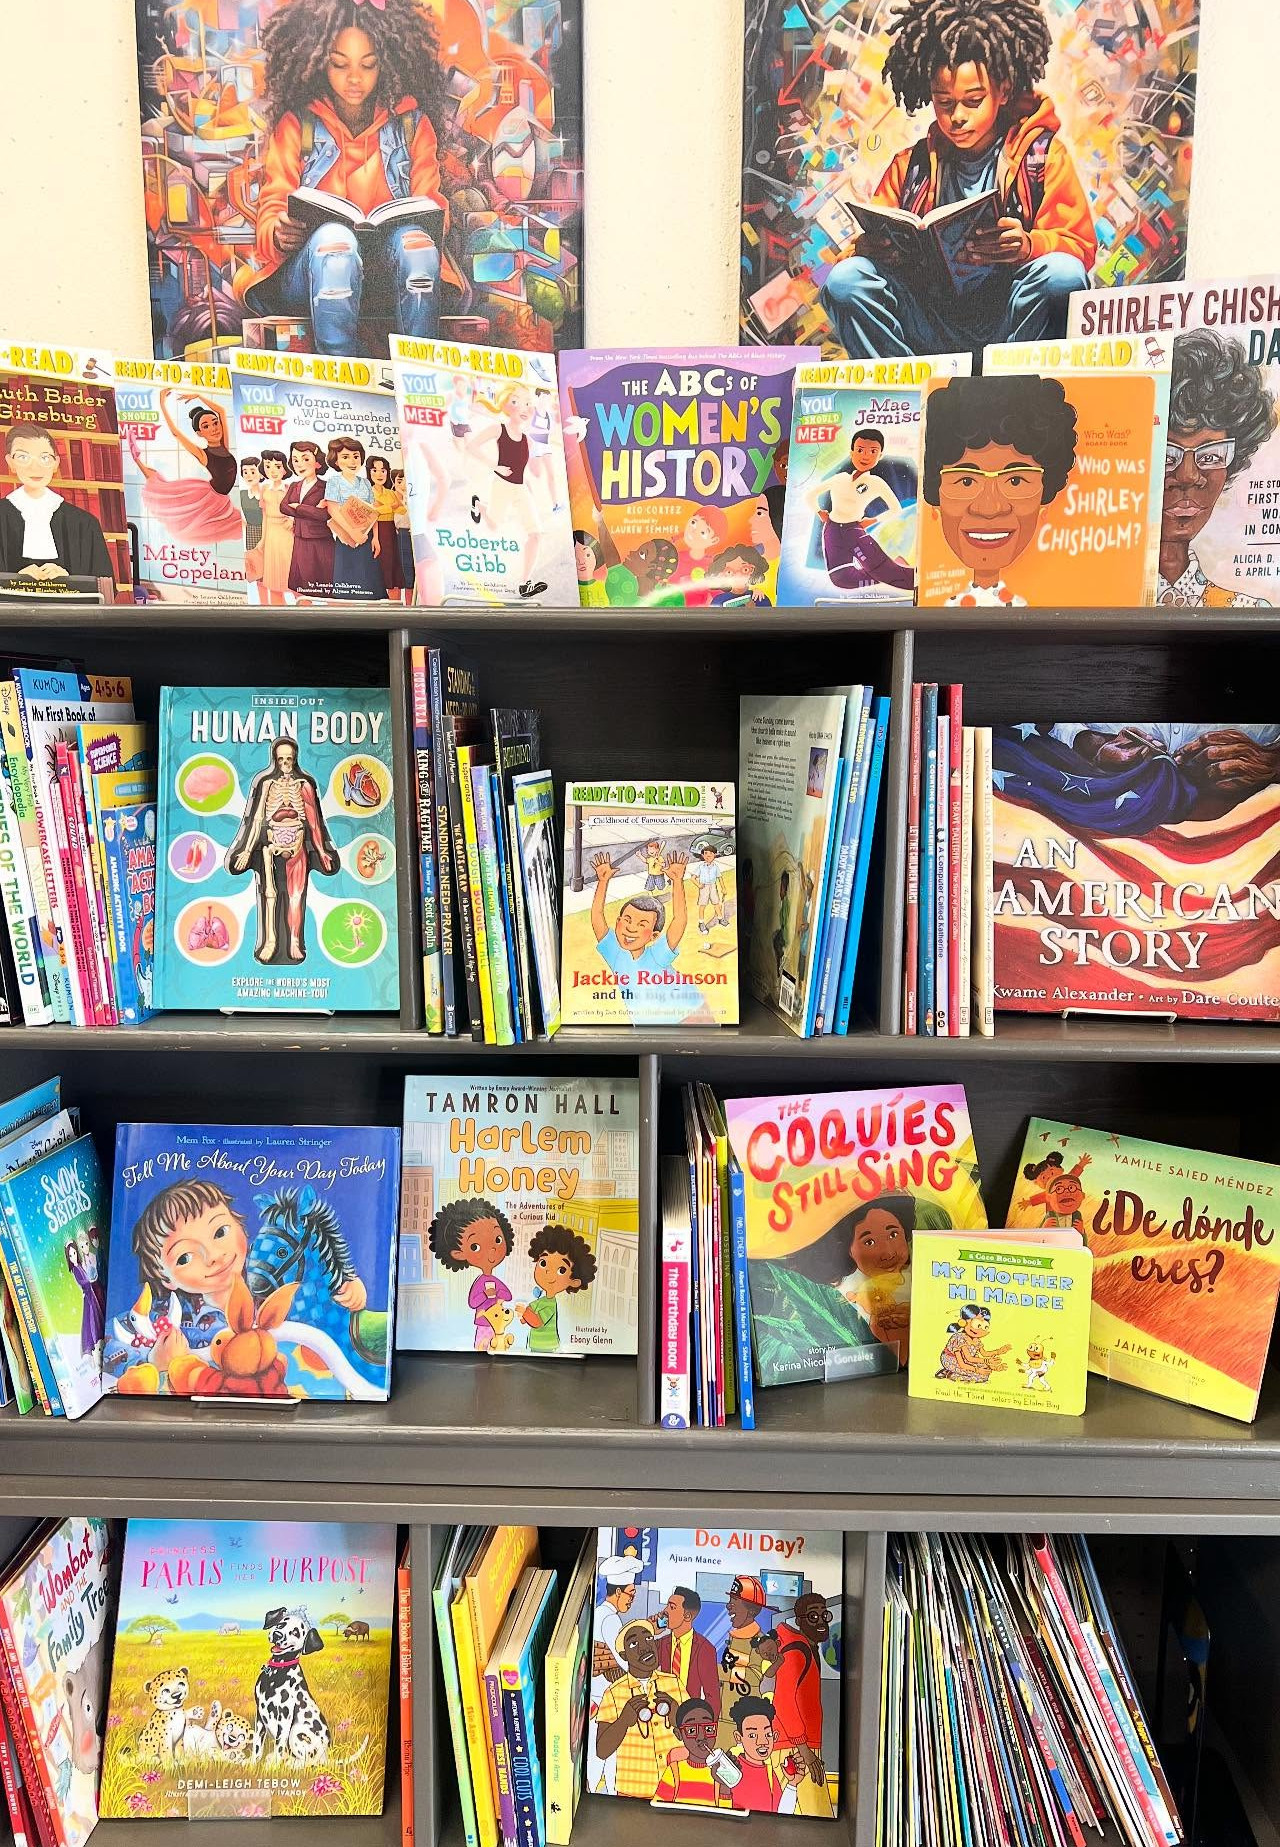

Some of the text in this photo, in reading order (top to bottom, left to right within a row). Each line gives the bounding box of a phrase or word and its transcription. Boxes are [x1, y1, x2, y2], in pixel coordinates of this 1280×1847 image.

[1081, 292, 1193, 335] SHIRLEY
[10, 347, 73, 374] READ
[397, 340, 523, 378] READY TO READ
[1071, 341, 1133, 367] READ
[114, 360, 182, 383] READY TO
[236, 353, 370, 386] READY TO READ
[800, 362, 932, 385] READY TO READ
[242, 387, 273, 402] YOU
[404, 376, 435, 393] YOU
[622, 380, 649, 396] THE
[740, 376, 758, 391] OF
[44, 387, 106, 407] Bader
[119, 394, 149, 409] YOU
[285, 393, 352, 410] Women
[803, 397, 832, 413] YOU
[869, 398, 910, 413] Mae
[0, 404, 97, 430] Ginsburg
[242, 419, 280, 432] MEET
[293, 417, 399, 436] the Computer
[301, 408, 392, 423] Who Launched
[406, 410, 442, 424] MEET
[595, 397, 782, 447] WOMEN'S
[368, 435, 401, 452] Age
[798, 426, 834, 441] MEET
[600, 446, 776, 501] HISTORY
[1077, 455, 1145, 475] WHO WAS
[1064, 484, 1144, 517] SHIRLEY
[436, 528, 520, 552] Roberta
[1037, 521, 1142, 556] CHISHOLM?
[143, 544, 212, 566] Misty
[455, 554, 506, 573] Gibb
[300, 698, 324, 706] OUT
[46, 707, 96, 721] First Book of
[191, 710, 384, 744] HUMAN BODY
[9, 757, 26, 818] Encyclopedia
[572, 786, 701, 808] READY TO READ
[416, 748, 436, 948] KING RAGTIME Scott Joplin
[1012, 838, 1078, 870] AN
[437, 805, 452, 955] STANDING NEED PRAYER
[993, 879, 1280, 923] AMERICAN
[0, 849, 35, 986] OF THE WORLD
[1039, 928, 1209, 973] STORY
[572, 970, 728, 988] Jackie Robinson
[592, 989, 616, 1000] and
[991, 985, 1221, 1005] Kwame Alexander Art by Dare
[426, 1093, 620, 1115] TAMRON HALL
[778, 1098, 812, 1120] THE
[176, 1135, 199, 1144] Mem
[201, 1135, 216, 1144] Fox
[255, 1138, 264, 1147] by
[266, 1137, 296, 1146] Lauren
[298, 1137, 332, 1148] Stringer
[449, 1117, 592, 1155] Harlem
[747, 1092, 956, 1183] COQUÍES
[40, 1158, 85, 1202] SNOW
[122, 1149, 386, 1190] Tell Me About Your Day Today
[458, 1157, 580, 1200] Honey
[1114, 1153, 1274, 1197] YAMILE SAIED MÉNDEZ
[43, 1184, 92, 1234] SISTERS
[505, 1201, 565, 1211] The Adventures of
[768, 1166, 848, 1232] STILL
[519, 1212, 556, 1221] Curious Kid
[1092, 1189, 1275, 1252] ¿De dónde
[976, 1253, 1042, 1266] Coco Rocho book
[668, 1267, 679, 1288] The
[975, 1266, 1073, 1291] MOTHER
[1131, 1249, 1225, 1294] eres?
[983, 1287, 1064, 1310] MADRE
[571, 1335, 613, 1345] Ebony Glenn
[667, 1341, 679, 1369] BOOK
[1114, 1338, 1157, 1358] JAIME
[1162, 1353, 1189, 1369] KIM
[150, 1546, 216, 1556] PRINCESS
[695, 1529, 805, 1559] Do All Day?
[229, 1562, 264, 1571] FINDS
[669, 1553, 722, 1565] Ajuan Mance
[38, 1527, 95, 1615] Wombat
[140, 1559, 223, 1592] PARIS
[400, 1588, 410, 1603] The
[399, 1606, 410, 1620] Big
[47, 1578, 110, 1673] Family Tree
[400, 1622, 410, 1642] Book
[401, 1654, 411, 1675] Bible
[401, 1677, 411, 1699] Facts
[177, 1779, 301, 1790] DEMI-LEIGH TEBOW
